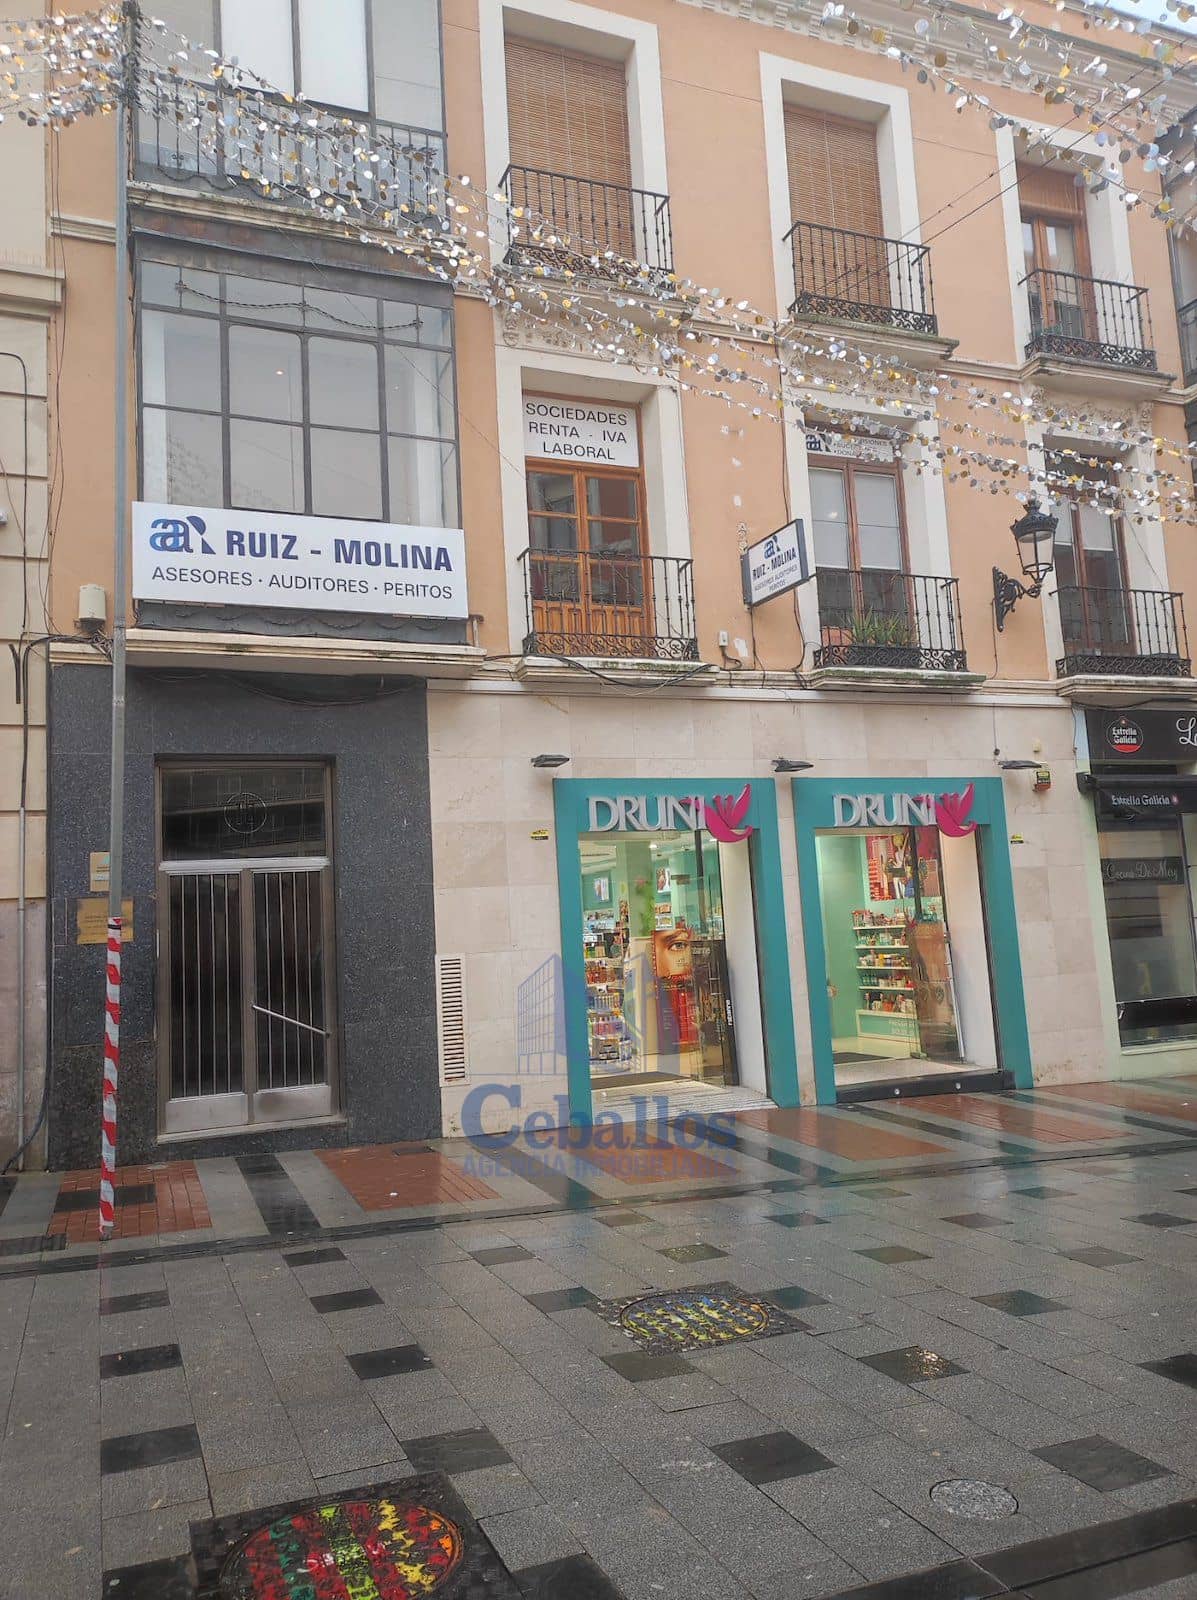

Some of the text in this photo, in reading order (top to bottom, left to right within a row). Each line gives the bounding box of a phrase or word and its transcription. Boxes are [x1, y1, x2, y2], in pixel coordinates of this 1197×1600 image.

[526, 403, 627, 426] SOCIEDADES
[529, 422, 580, 438] RENTA
[603, 430, 627, 443] IVA
[543, 442, 615, 460] LABORAL
[227, 530, 298, 560] RUIZ
[334, 538, 453, 571] MOLINA
[752, 563, 766, 580] RUIZ
[771, 547, 797, 570] MOLINA
[152, 566, 453, 600] ASESORES AUDITORES PERITOS
[1112, 727, 1137, 736] Estrella
[1113, 735, 1137, 744] Galicia
[833, 793, 938, 827] DRUNI
[1111, 794, 1170, 806] Estrella Galicia
[588, 796, 708, 832] DRUNI
